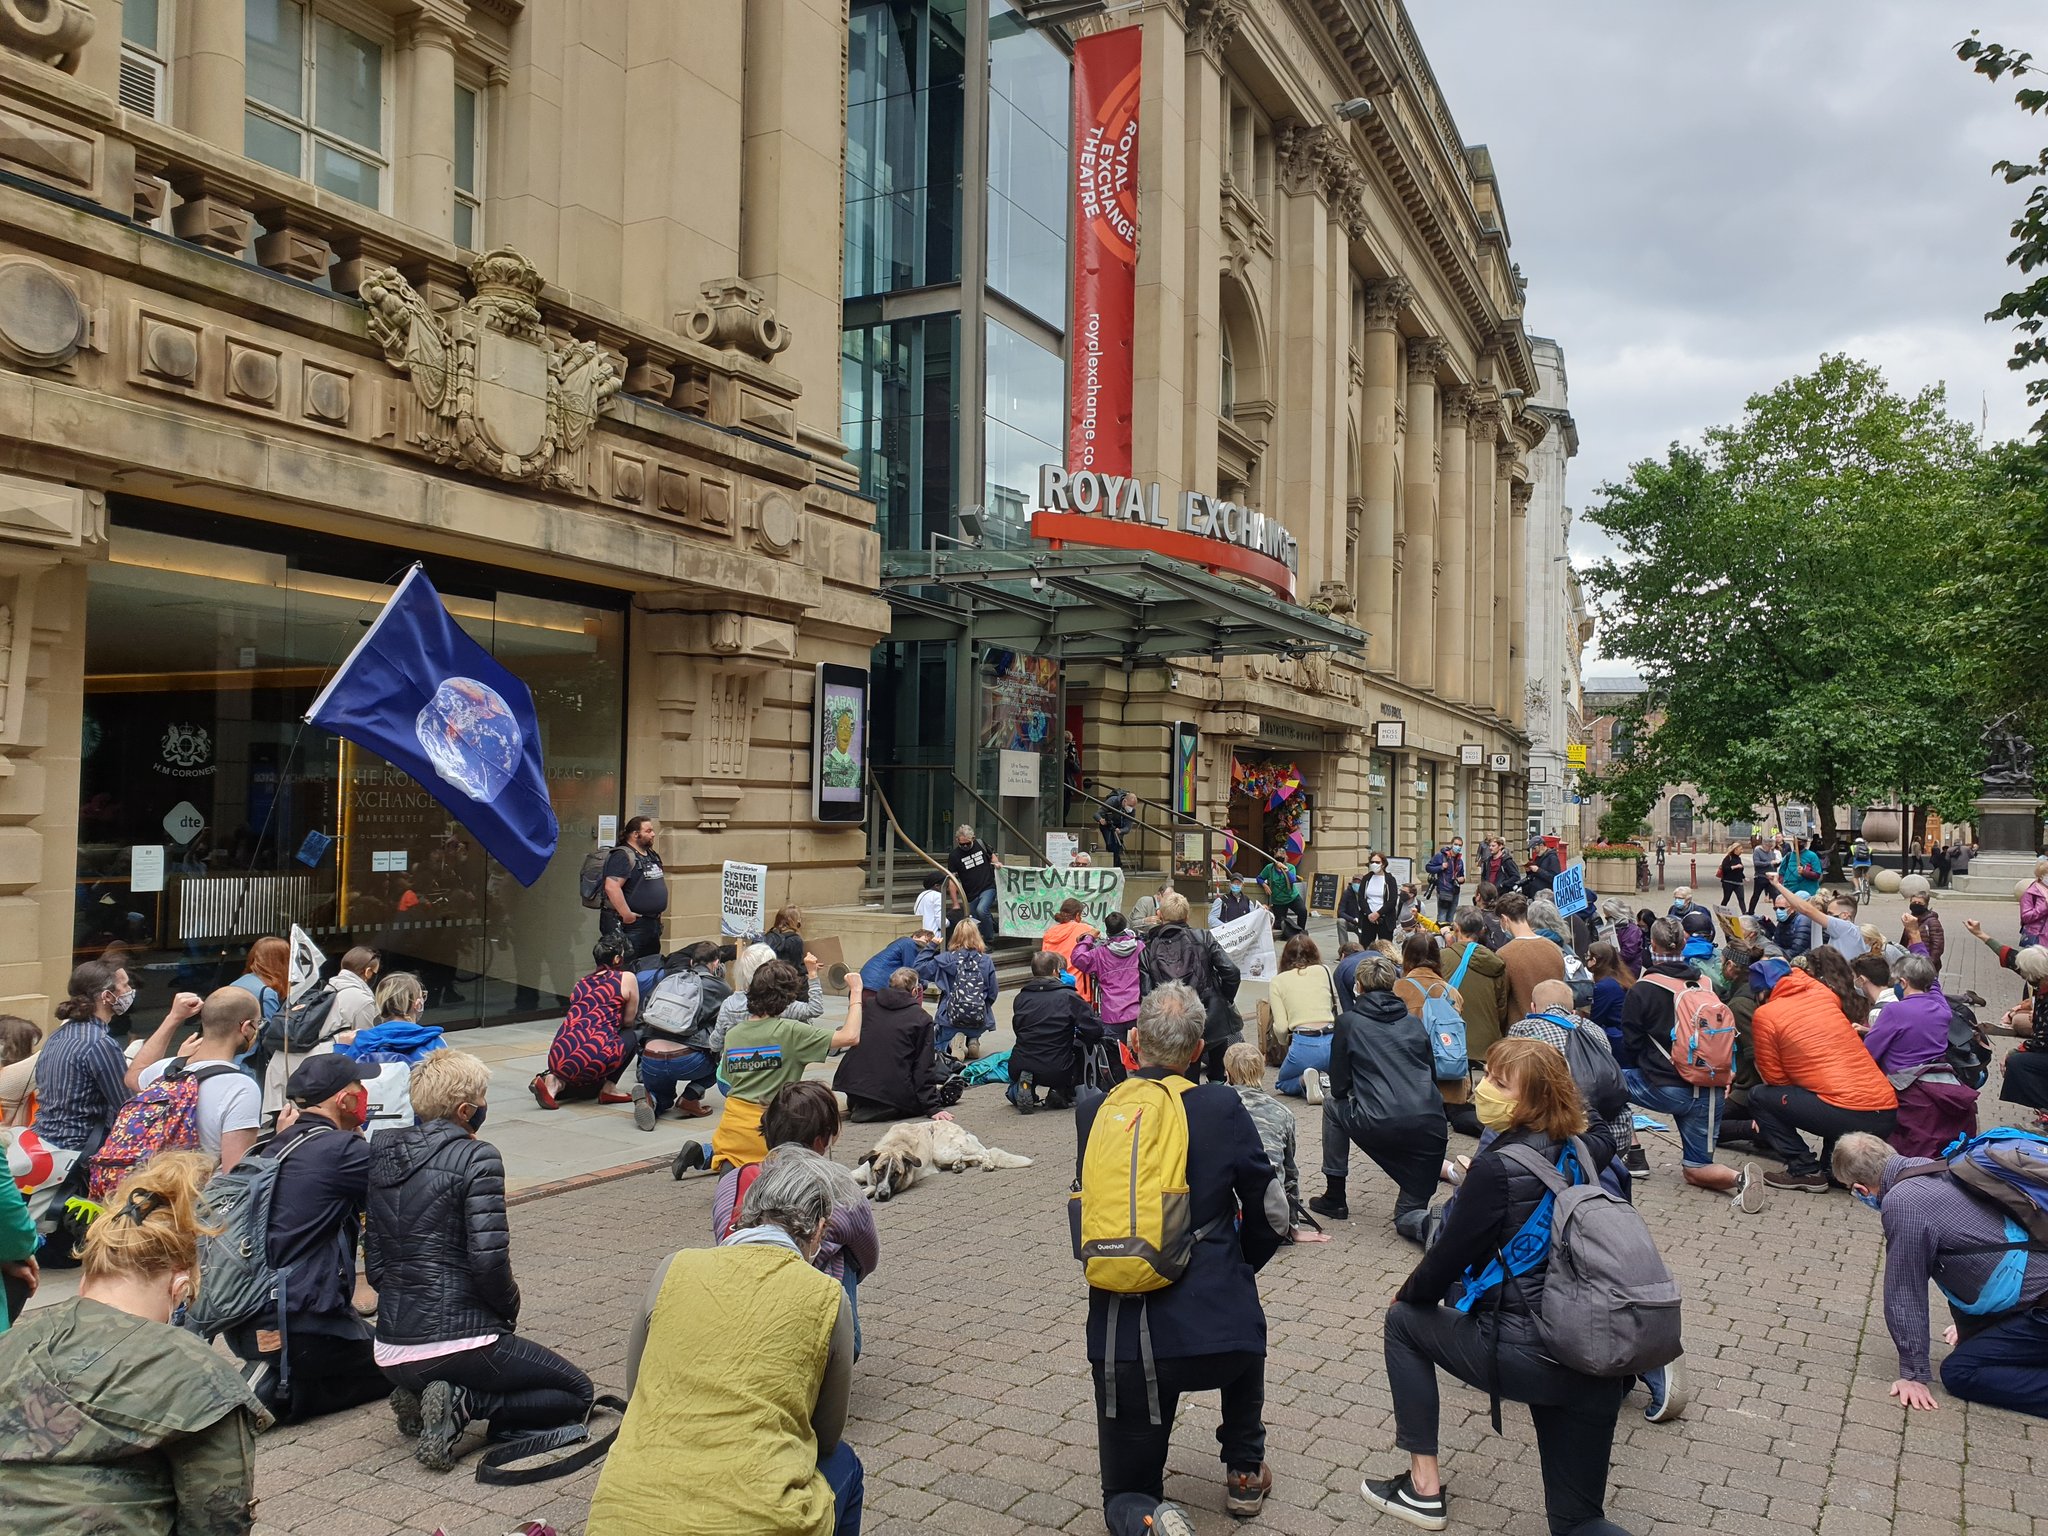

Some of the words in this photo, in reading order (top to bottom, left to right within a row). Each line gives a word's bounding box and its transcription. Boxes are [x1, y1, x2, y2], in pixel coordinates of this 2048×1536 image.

[1114, 120, 1137, 192] ROYAL
[1079, 126, 1104, 219] THEATRE
[1097, 143, 1135, 242] EXCHANGE
[1082, 313, 1104, 471] royalexchange.co.
[1039, 464, 1169, 526] ROYAL
[1178, 489, 1299, 577] EXCHANGE
[171, 764, 218, 778] CORONER
[180, 815, 200, 828] dte
[724, 870, 757, 883] SYSTEM
[1006, 869, 1118, 895] REWILD
[1556, 870, 1571, 891] THIS
[1571, 866, 1580, 884] IS
[724, 879, 758, 892] CHANGE
[724, 888, 740, 898] NOT
[1555, 880, 1584, 908] CHANGE
[723, 896, 758, 910] CLIMATE
[723, 905, 758, 918] CHANGE
[1238, 930, 1256, 943] Branch
[729, 1058, 778, 1072] patagonia
[1097, 1242, 1125, 1251] Quechua
